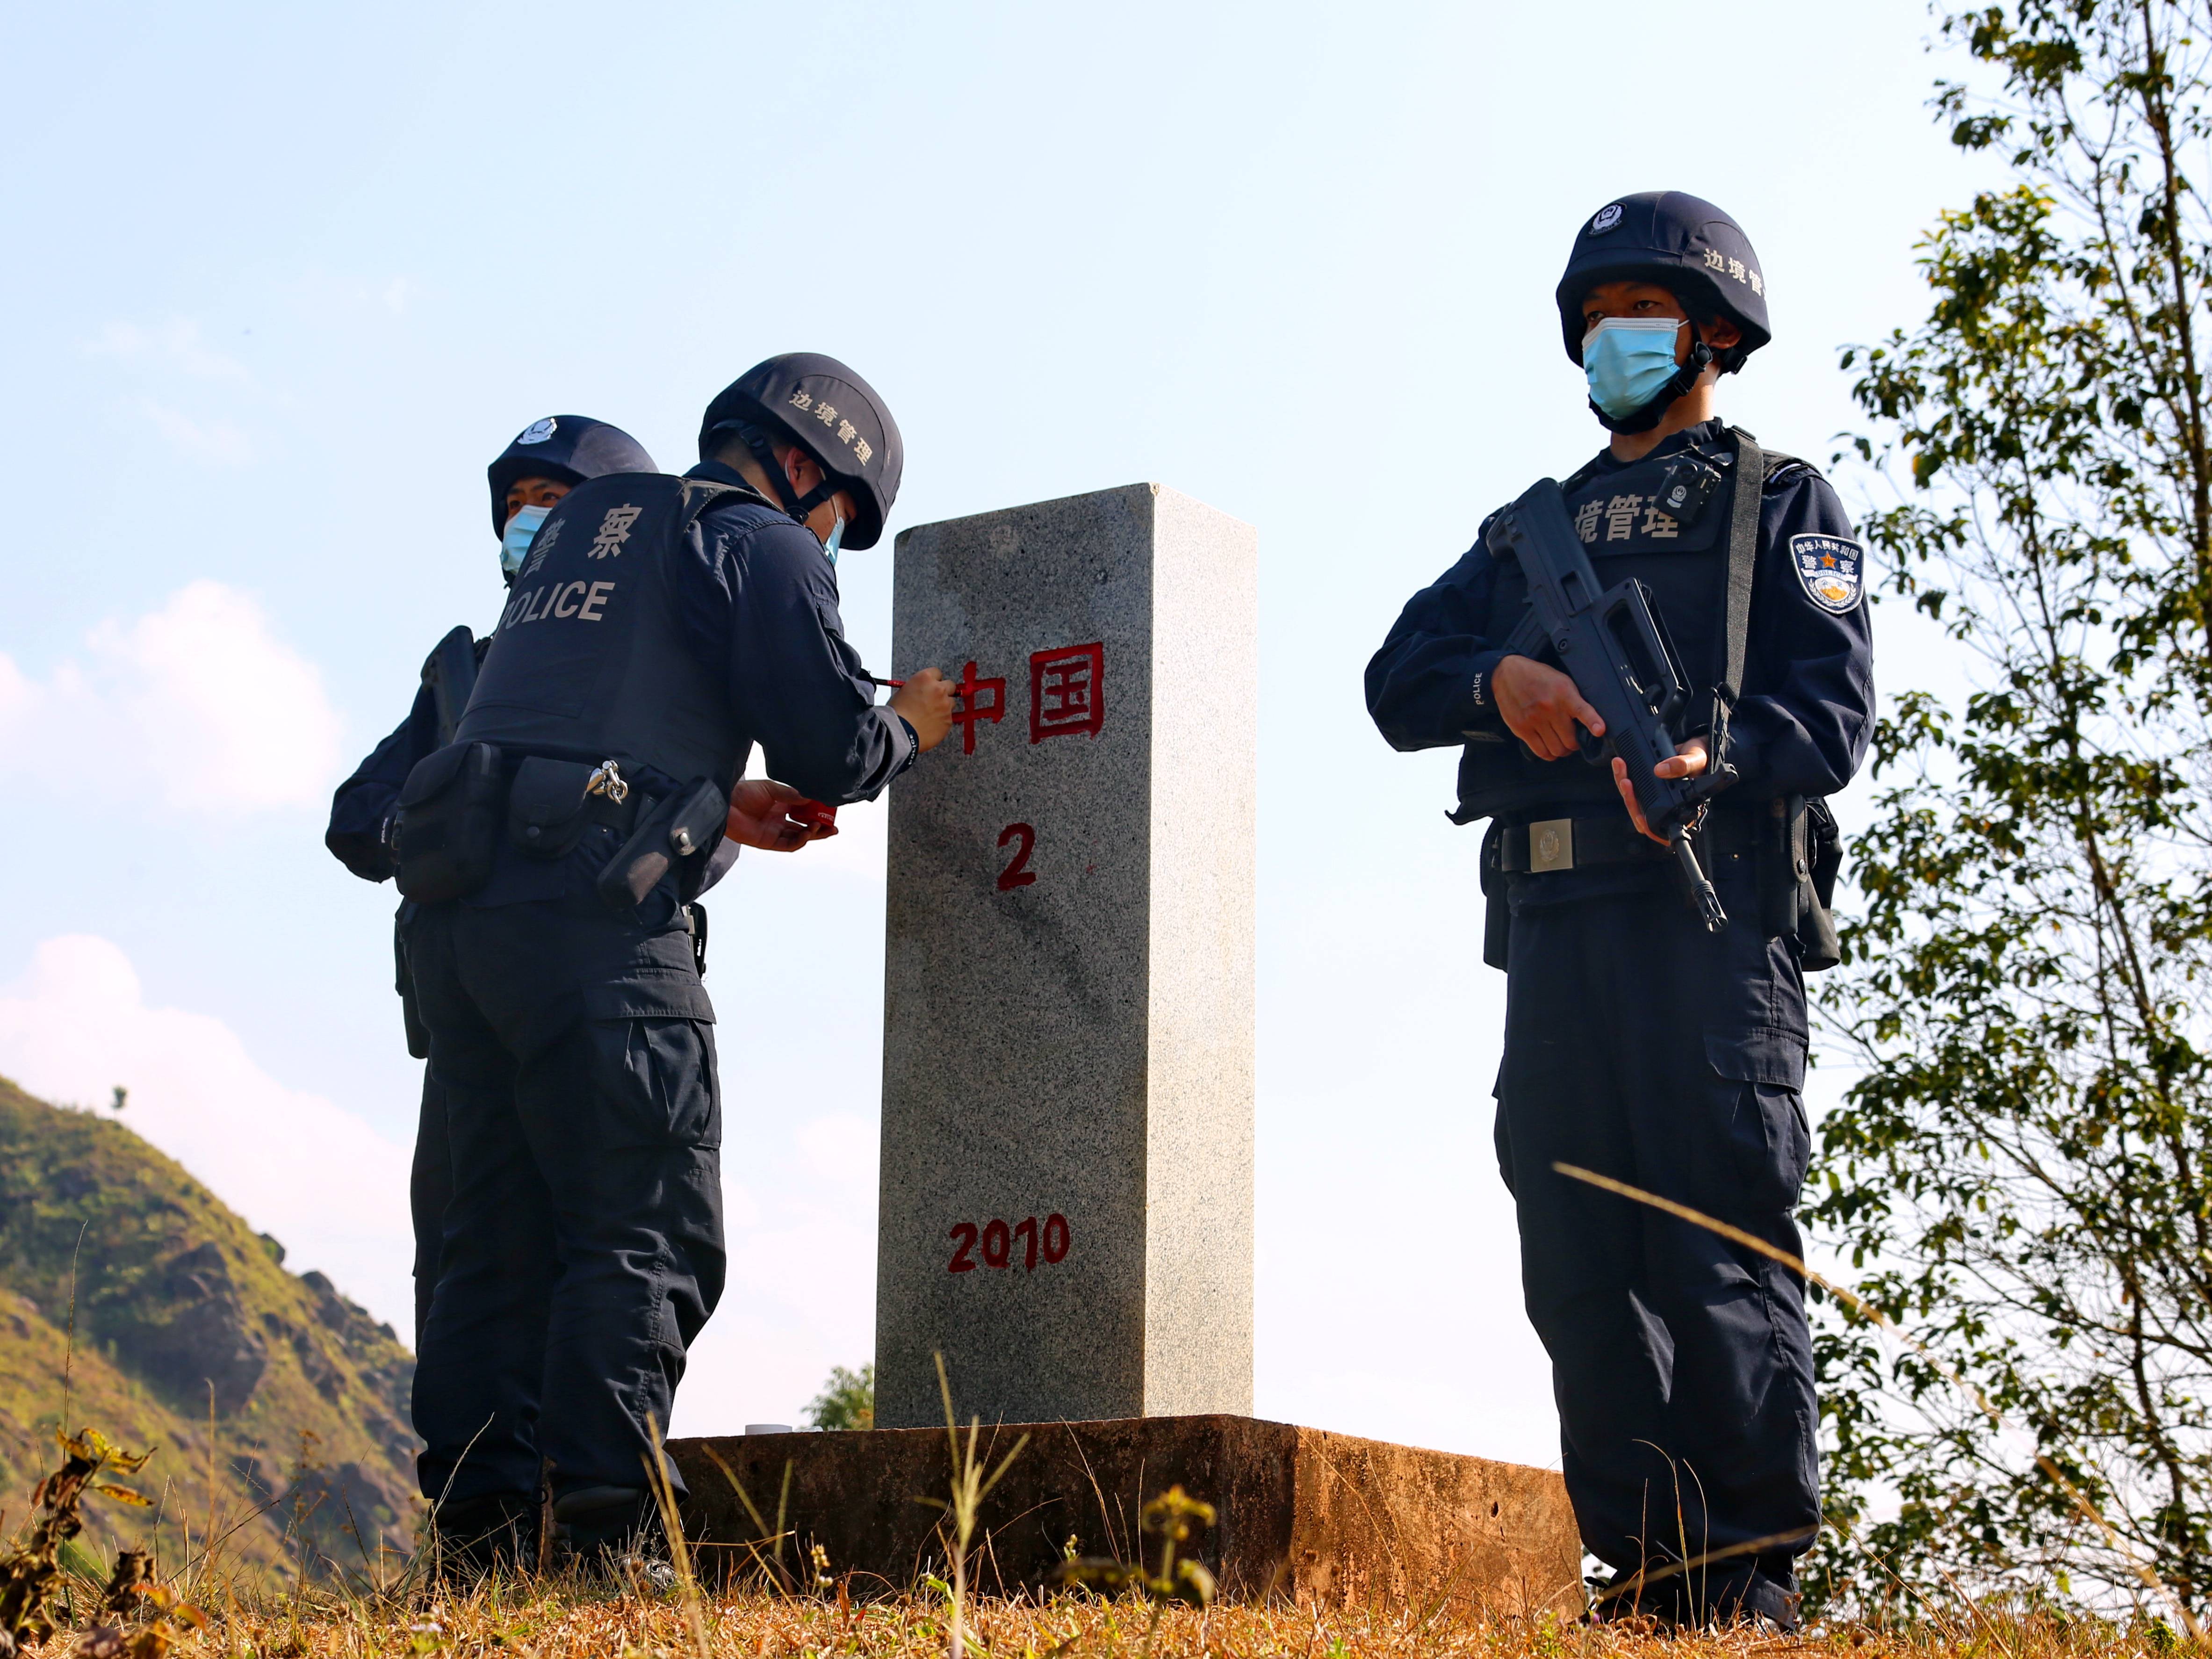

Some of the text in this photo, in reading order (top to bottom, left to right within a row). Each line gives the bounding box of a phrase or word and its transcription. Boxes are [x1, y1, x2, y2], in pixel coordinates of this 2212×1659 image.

[1703, 248, 1766, 300] 边境管
[788, 390, 872, 467] 边境管理
[524, 503, 643, 578] 警察
[1574, 494, 1679, 543] 境管理
[1795, 540, 1859, 561] 中华人民共和国
[1801, 555, 1855, 574] 警察
[498, 581, 615, 629] POLICE
[951, 642, 1104, 755] 中国
[1473, 672, 1484, 705] POLICE
[997, 823, 1036, 890] 2
[948, 1213, 1070, 1273] 2010
